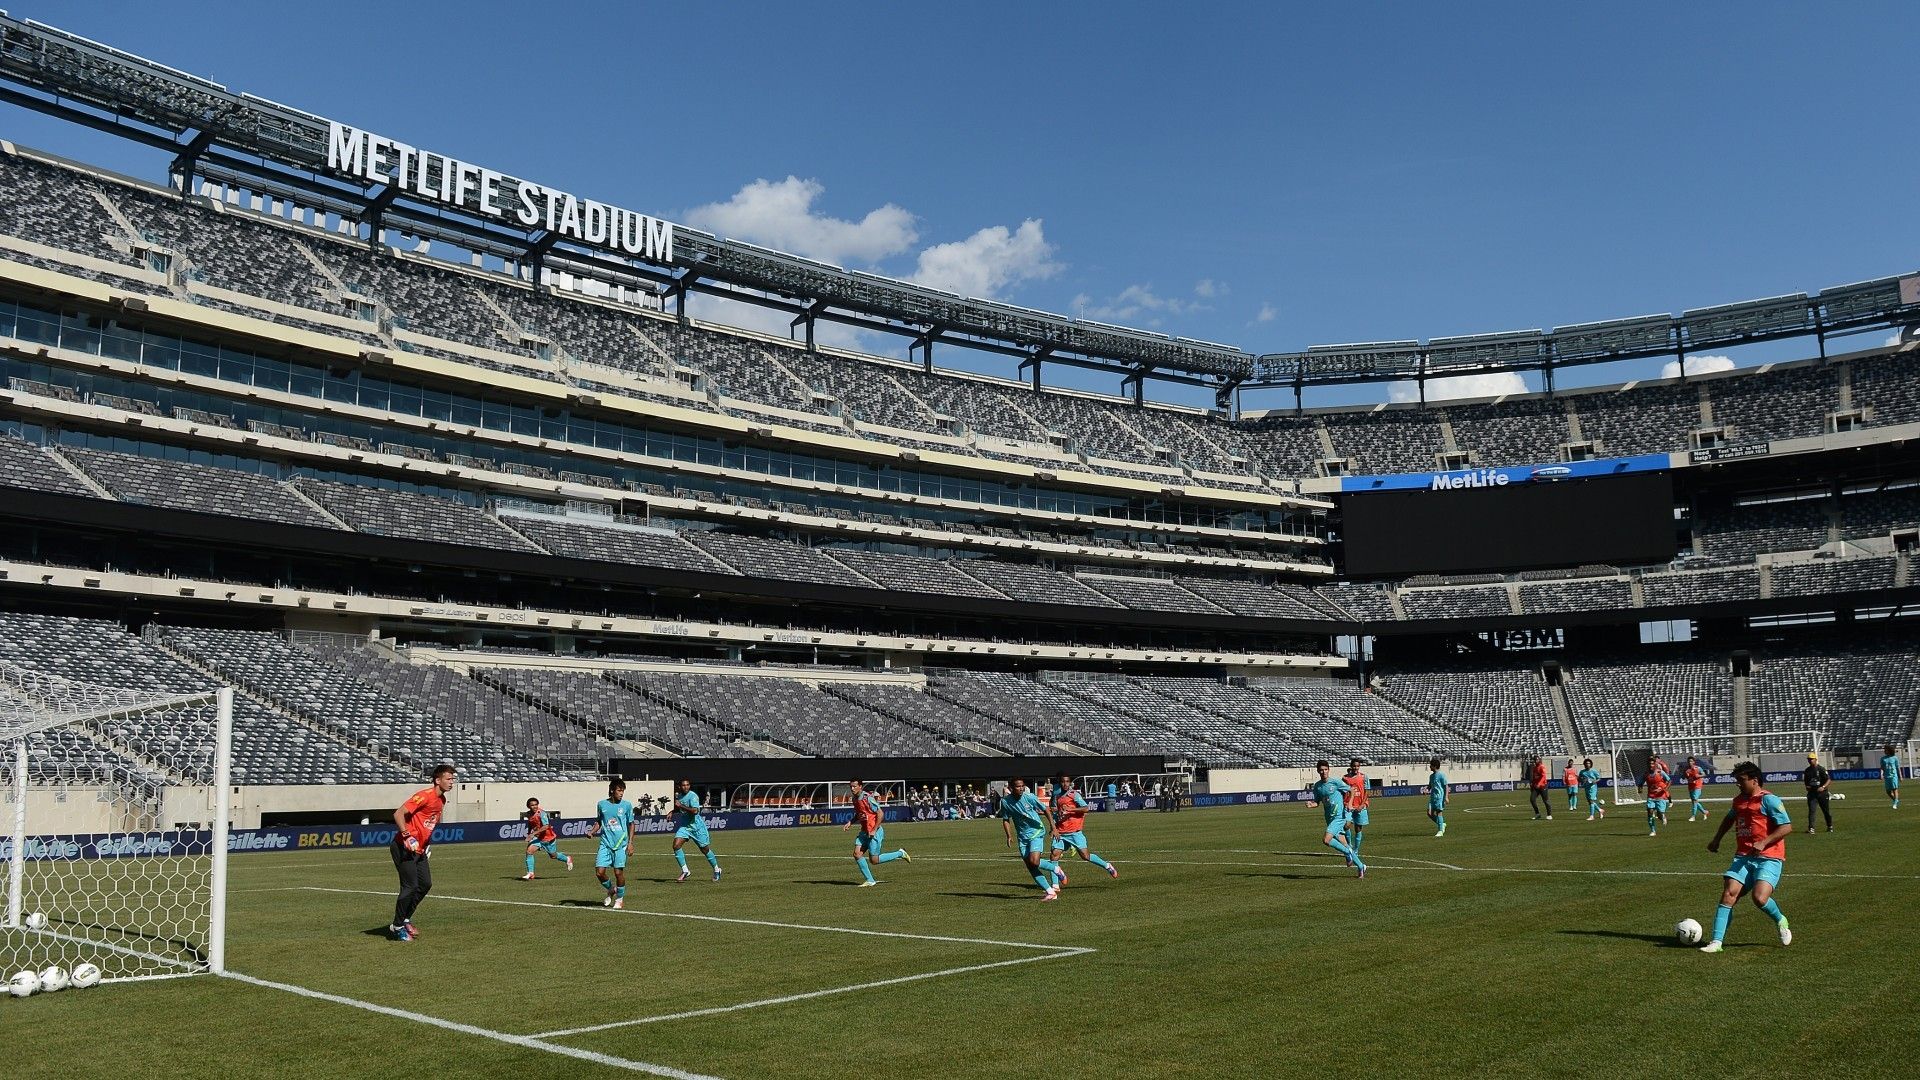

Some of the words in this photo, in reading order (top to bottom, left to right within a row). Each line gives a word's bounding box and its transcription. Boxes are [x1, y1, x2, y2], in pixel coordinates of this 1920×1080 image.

[328, 121, 501, 216] METLIFE
[516, 178, 673, 263] STADIUM
[1432, 470, 1509, 491] MetLife
[499, 612, 526, 622] pepsi
[653, 624, 688, 635] MetLife
[776, 632, 808, 643] Verizon
[1766, 774, 1798, 782] Gillette
[1833, 770, 1866, 780] WORLD
[1868, 769, 1880, 779] TO
[1246, 793, 1267, 803] Gillette
[1270, 792, 1290, 801] Gillette
[754, 814, 794, 826] Gillette
[799, 813, 832, 825] BRASIL
[298, 831, 353, 847] BRASIL
[431, 828, 464, 841] OUR
[95, 836, 173, 856] Gillette
